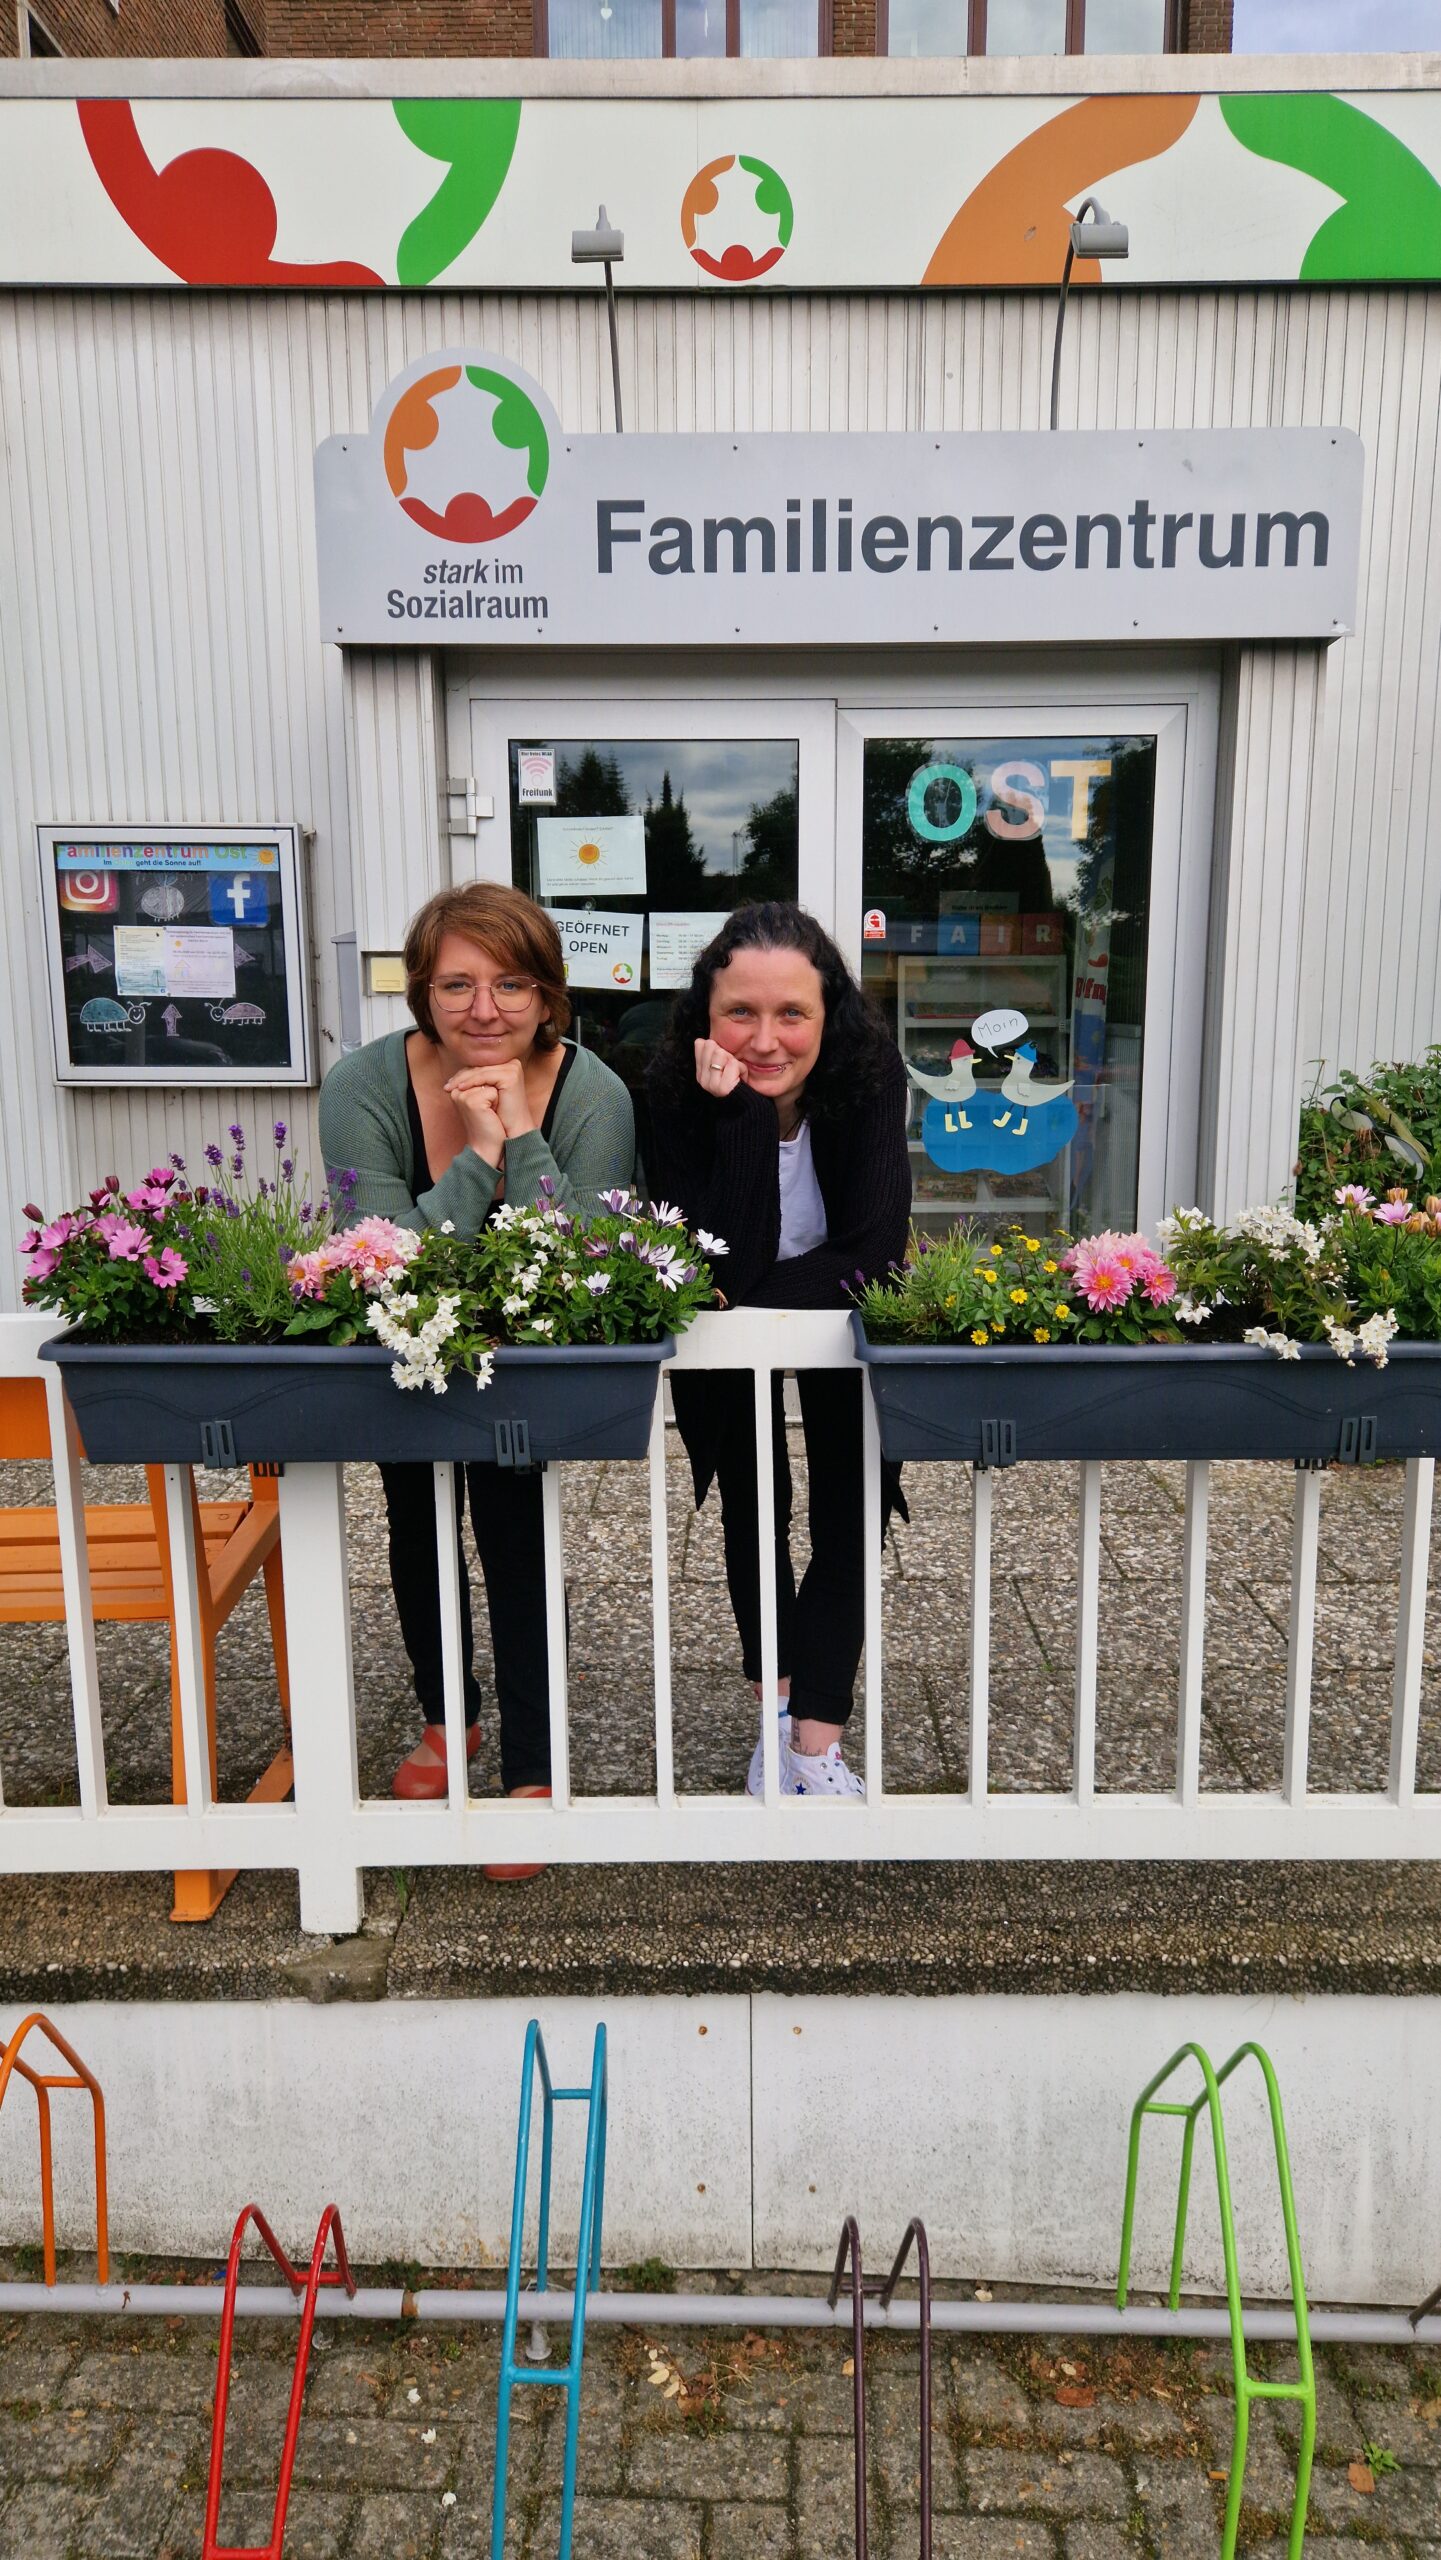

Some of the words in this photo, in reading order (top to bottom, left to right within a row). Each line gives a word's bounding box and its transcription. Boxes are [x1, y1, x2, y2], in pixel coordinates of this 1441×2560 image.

[596, 498, 1330, 575] Familienzentrum
[423, 558, 489, 584] stark
[494, 557, 523, 584] im
[387, 589, 549, 618] Sozialraum
[522, 788, 553, 797] Freifunk
[908, 759, 1112, 842] OST
[56, 845, 209, 858] Familienzentrum
[214, 845, 248, 859] Ost
[556, 919, 630, 937] GEÖFFNET
[569, 940, 608, 954] OPEN
[977, 1017, 1018, 1039] Moin
